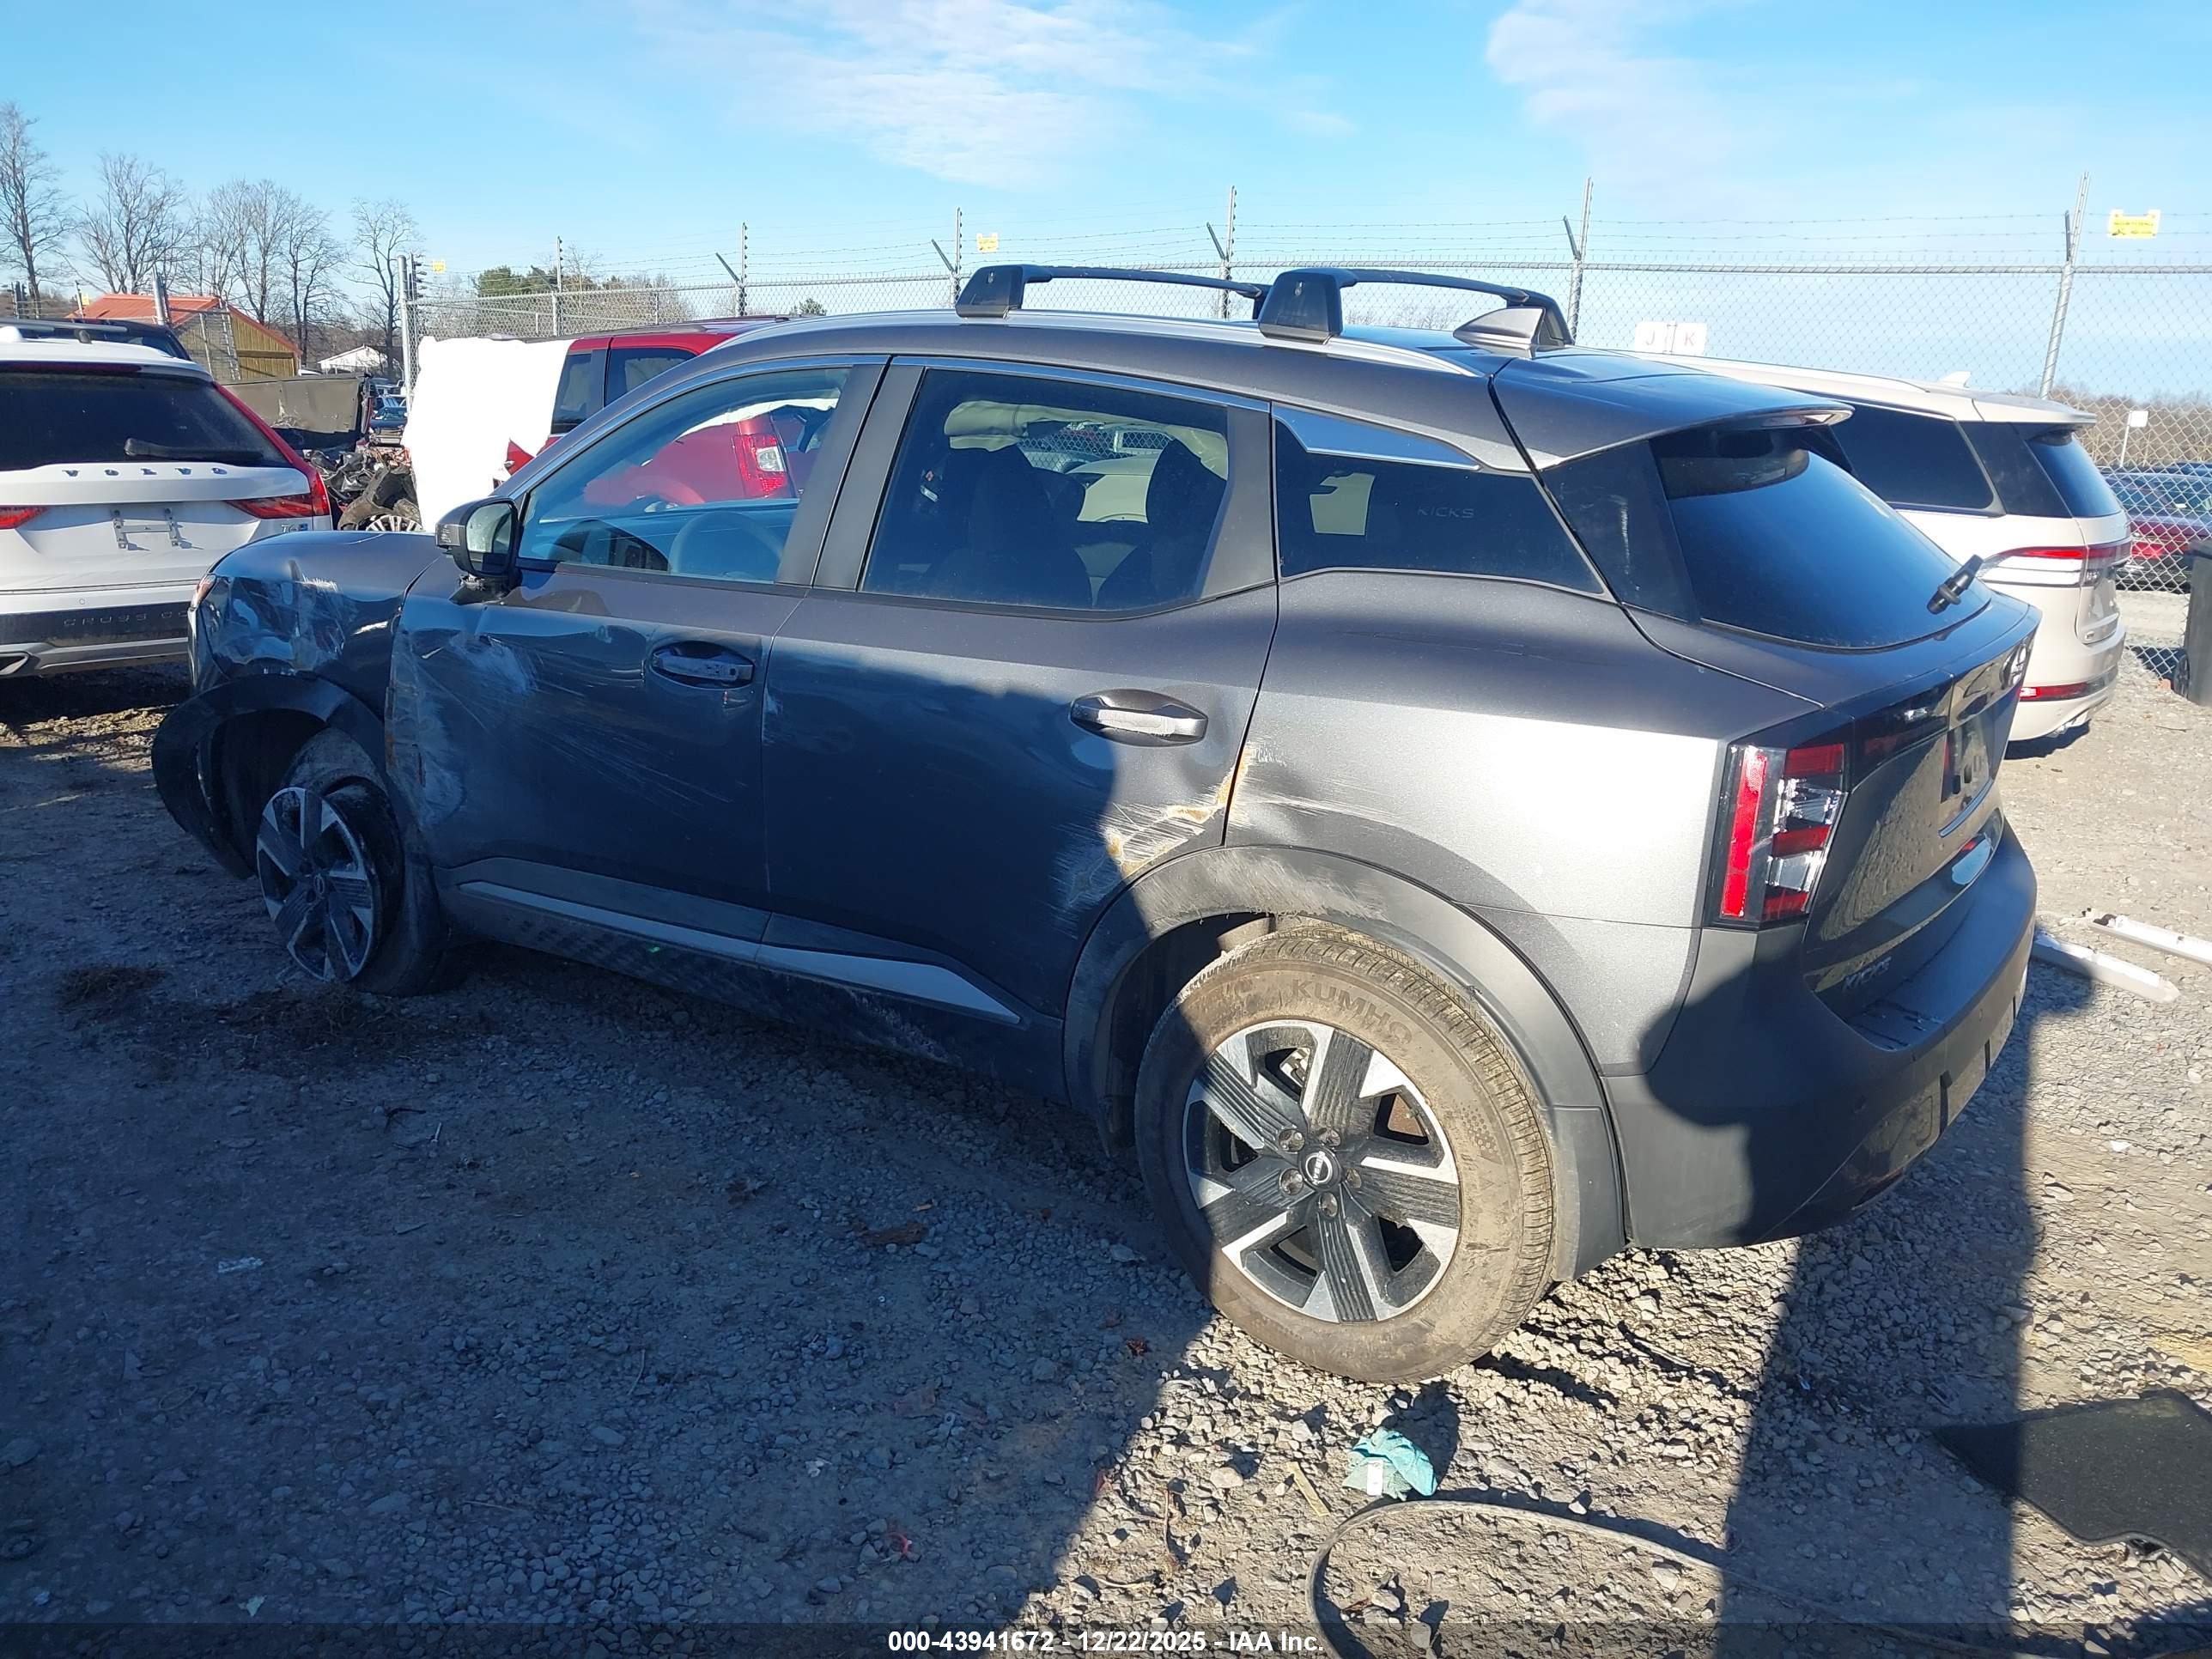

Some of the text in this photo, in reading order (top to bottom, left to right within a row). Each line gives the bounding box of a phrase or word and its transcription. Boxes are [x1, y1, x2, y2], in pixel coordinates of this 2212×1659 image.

[1684, 331, 1696, 346] K
[61, 466, 228, 477] VOLVO
[1417, 506, 1475, 519] KICKS
[1291, 978, 1413, 1045] KUMHO
